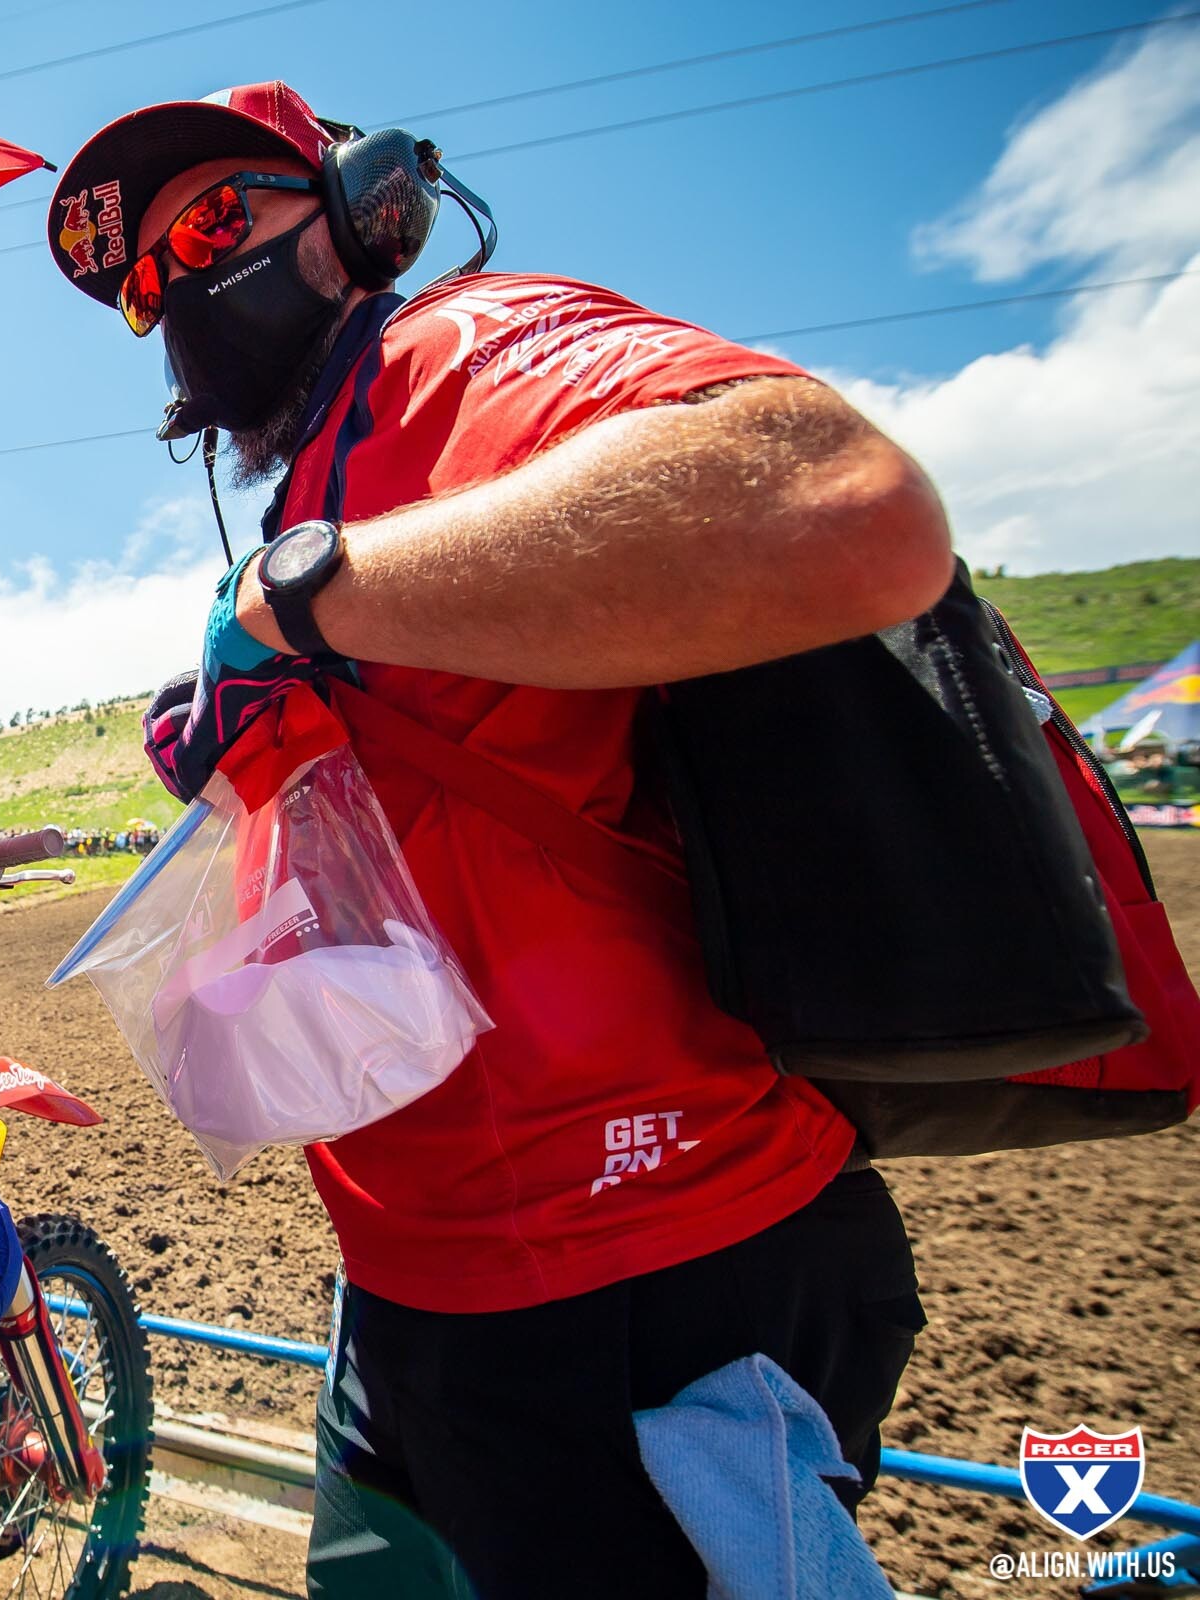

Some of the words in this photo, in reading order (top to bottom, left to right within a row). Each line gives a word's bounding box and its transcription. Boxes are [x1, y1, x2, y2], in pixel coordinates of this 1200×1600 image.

[221, 256, 271, 289] MISSION
[267, 915, 300, 942] FREEZER
[605, 1110, 683, 1151] GET
